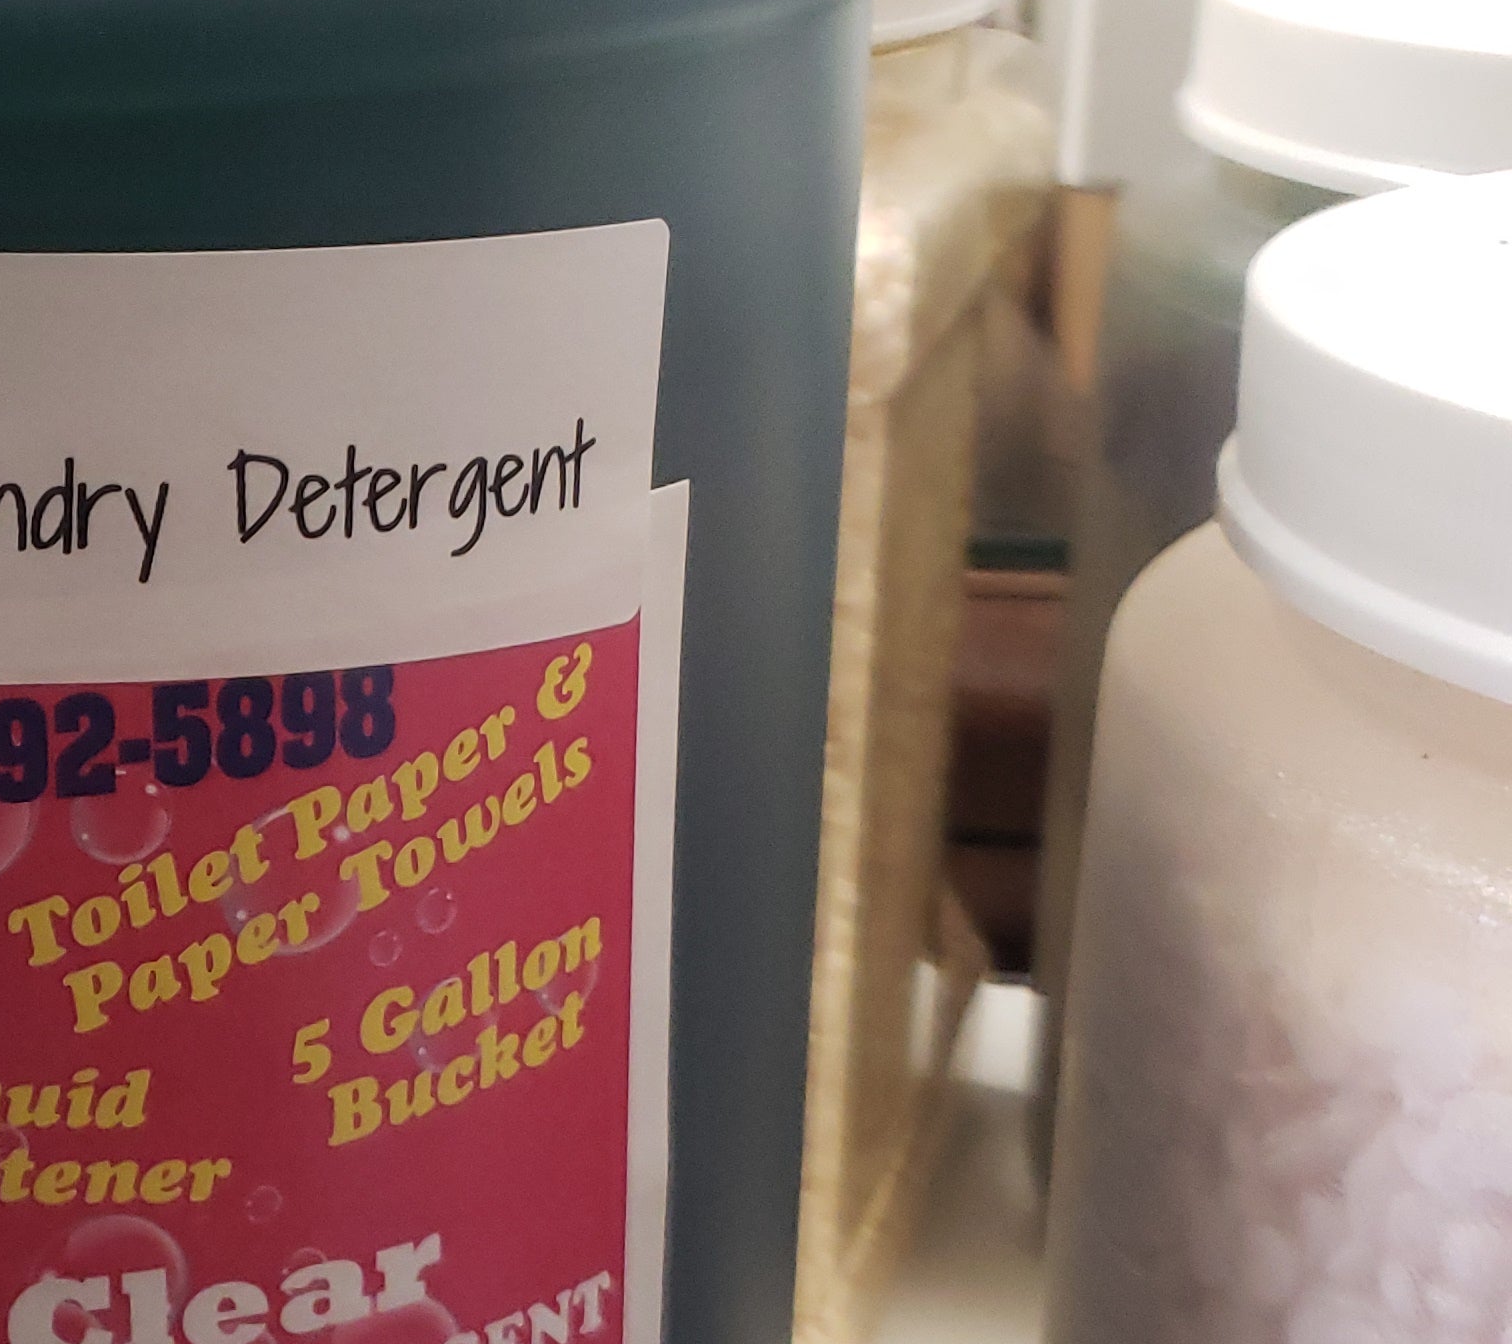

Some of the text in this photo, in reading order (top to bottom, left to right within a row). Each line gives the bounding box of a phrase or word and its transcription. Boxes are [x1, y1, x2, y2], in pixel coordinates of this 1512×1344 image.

[227, 417, 596, 558] Detergent
[7, 642, 593, 967] Toilet Paper &
[62, 736, 593, 1033] Paper Towels
[291, 916, 603, 1084] 5 Gallon
[327, 990, 585, 1146] Bucket
